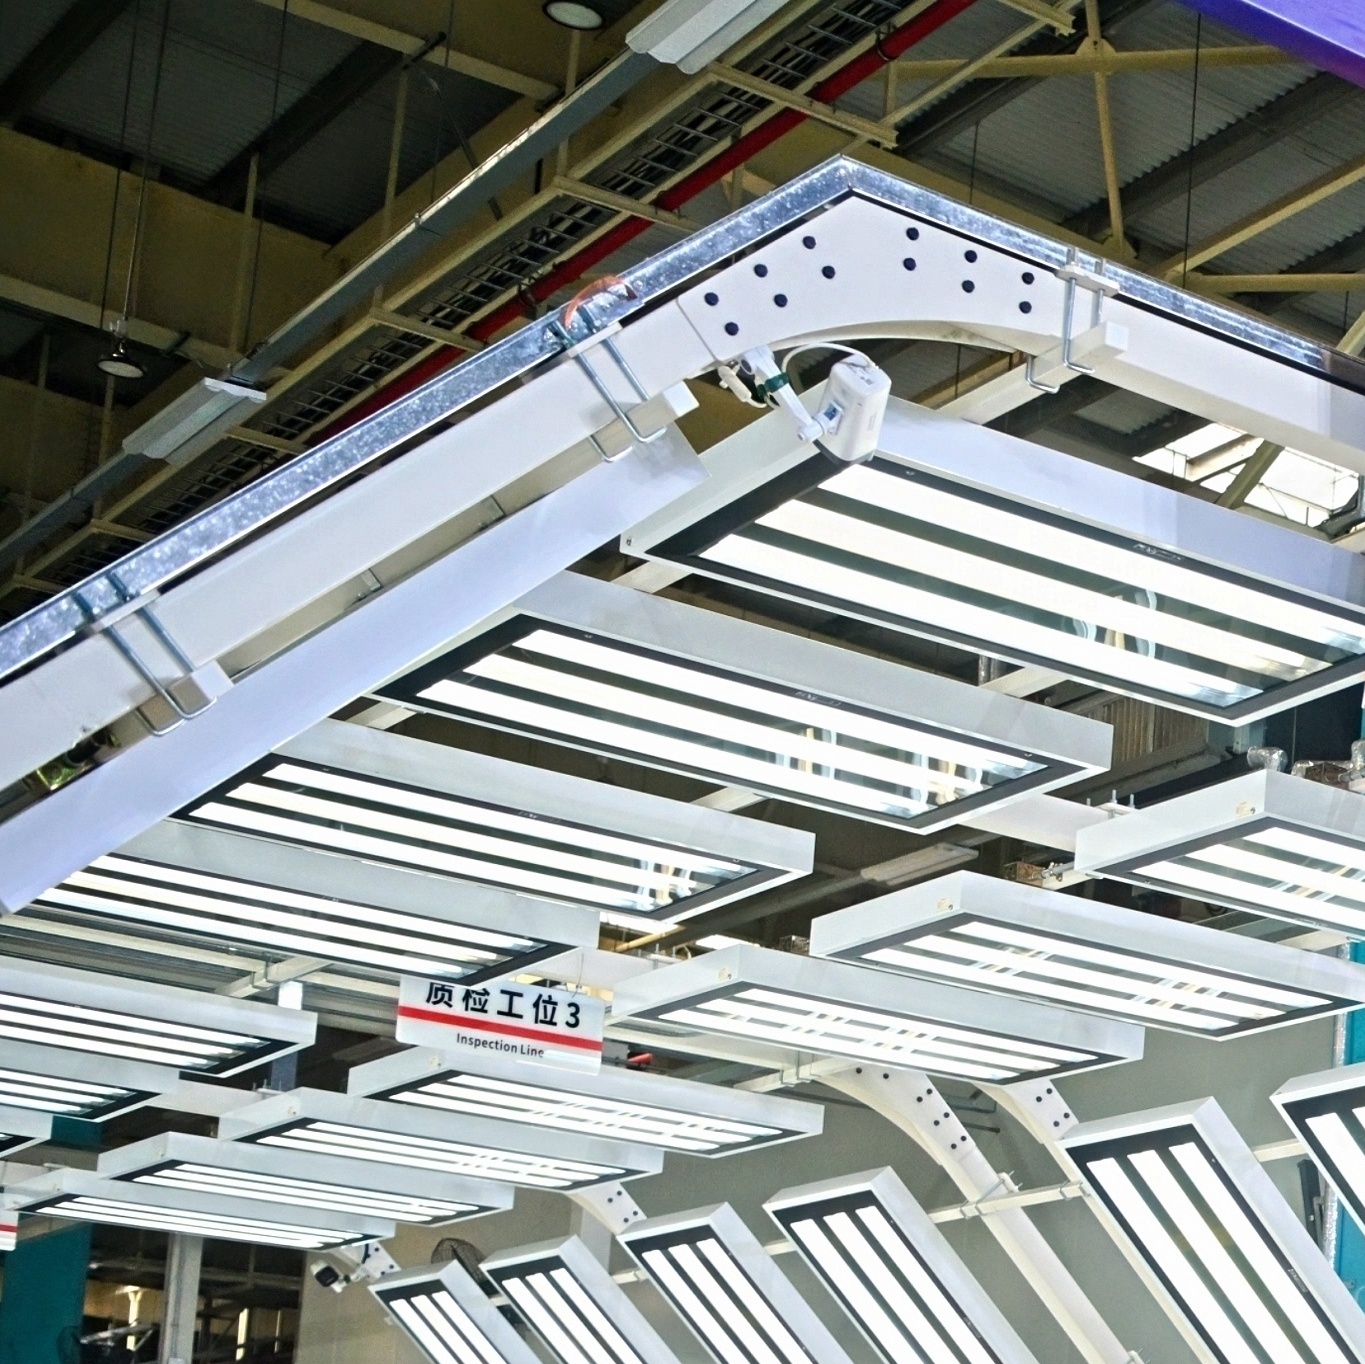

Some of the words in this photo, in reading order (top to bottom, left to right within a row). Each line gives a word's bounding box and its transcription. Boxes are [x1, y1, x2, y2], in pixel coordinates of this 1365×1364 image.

[425, 982, 581, 1029] 质检工位3
[456, 1032, 518, 1054] Inspection
[520, 1043, 545, 1058] Line
